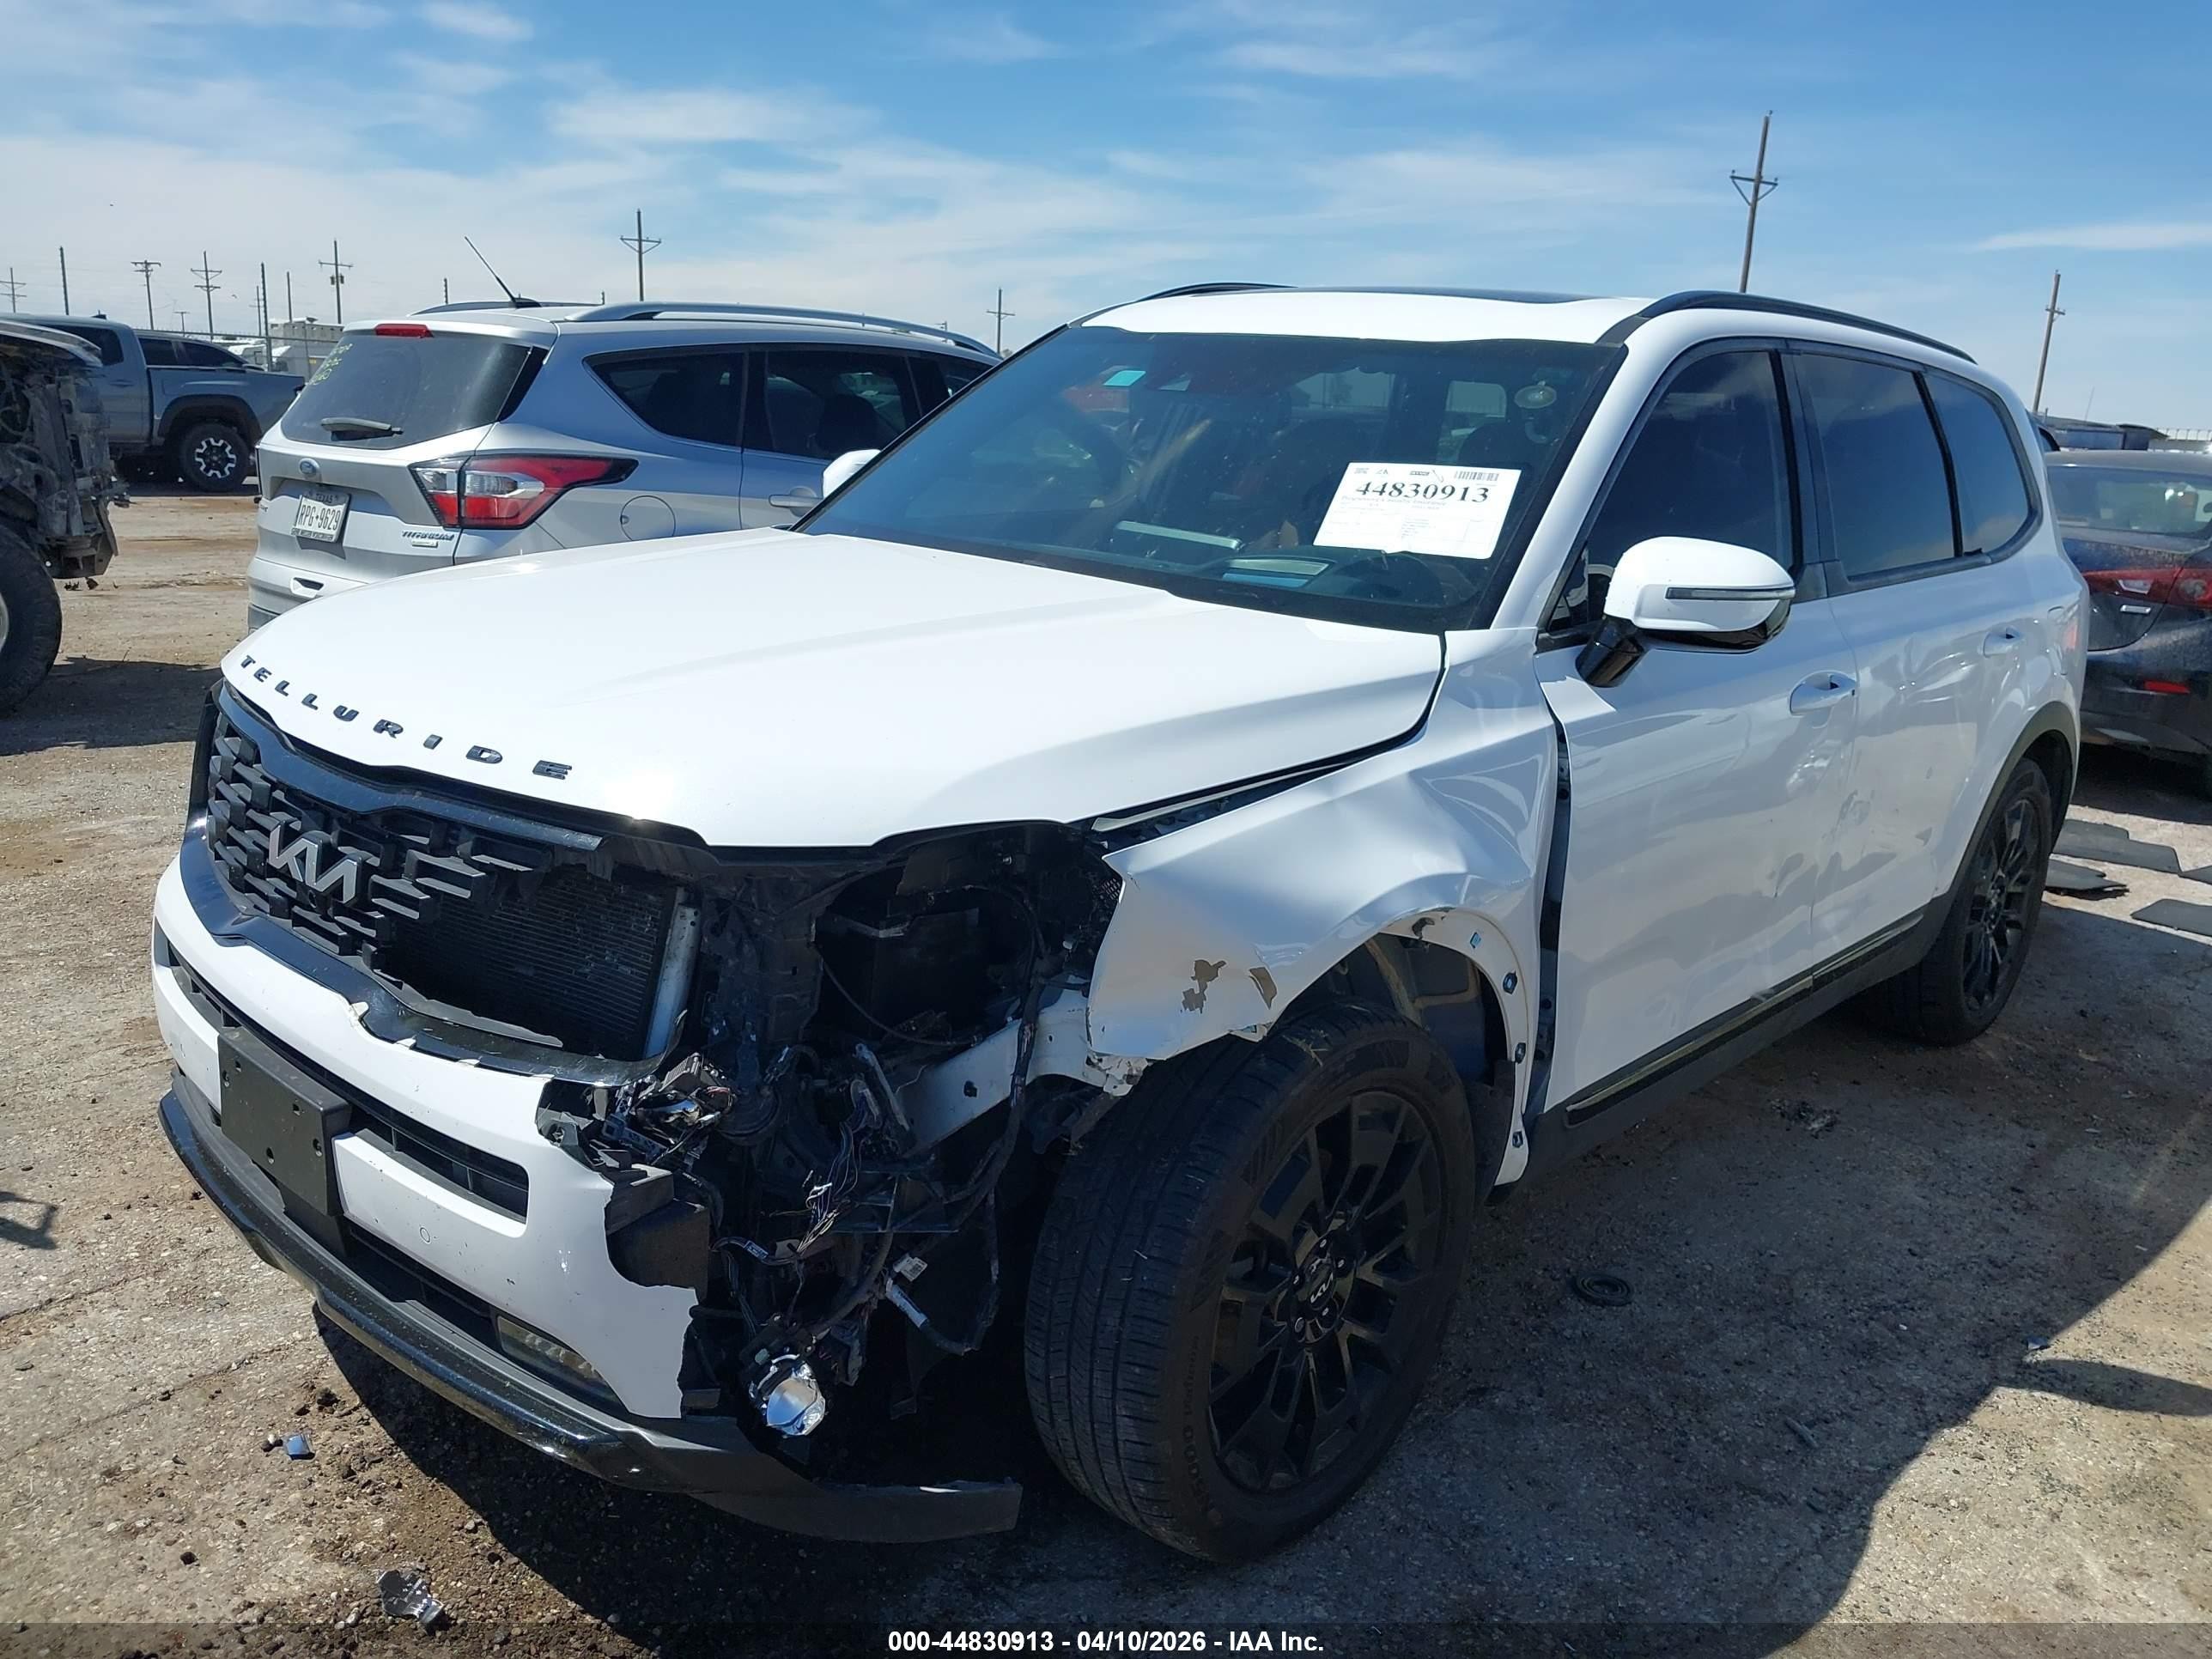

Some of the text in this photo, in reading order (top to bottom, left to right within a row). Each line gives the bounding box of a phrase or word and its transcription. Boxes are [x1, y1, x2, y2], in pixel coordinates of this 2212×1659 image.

[1356, 481, 1490, 503] 44830913
[240, 655, 573, 781] TELLURIDE
[268, 820, 361, 905] KIA
